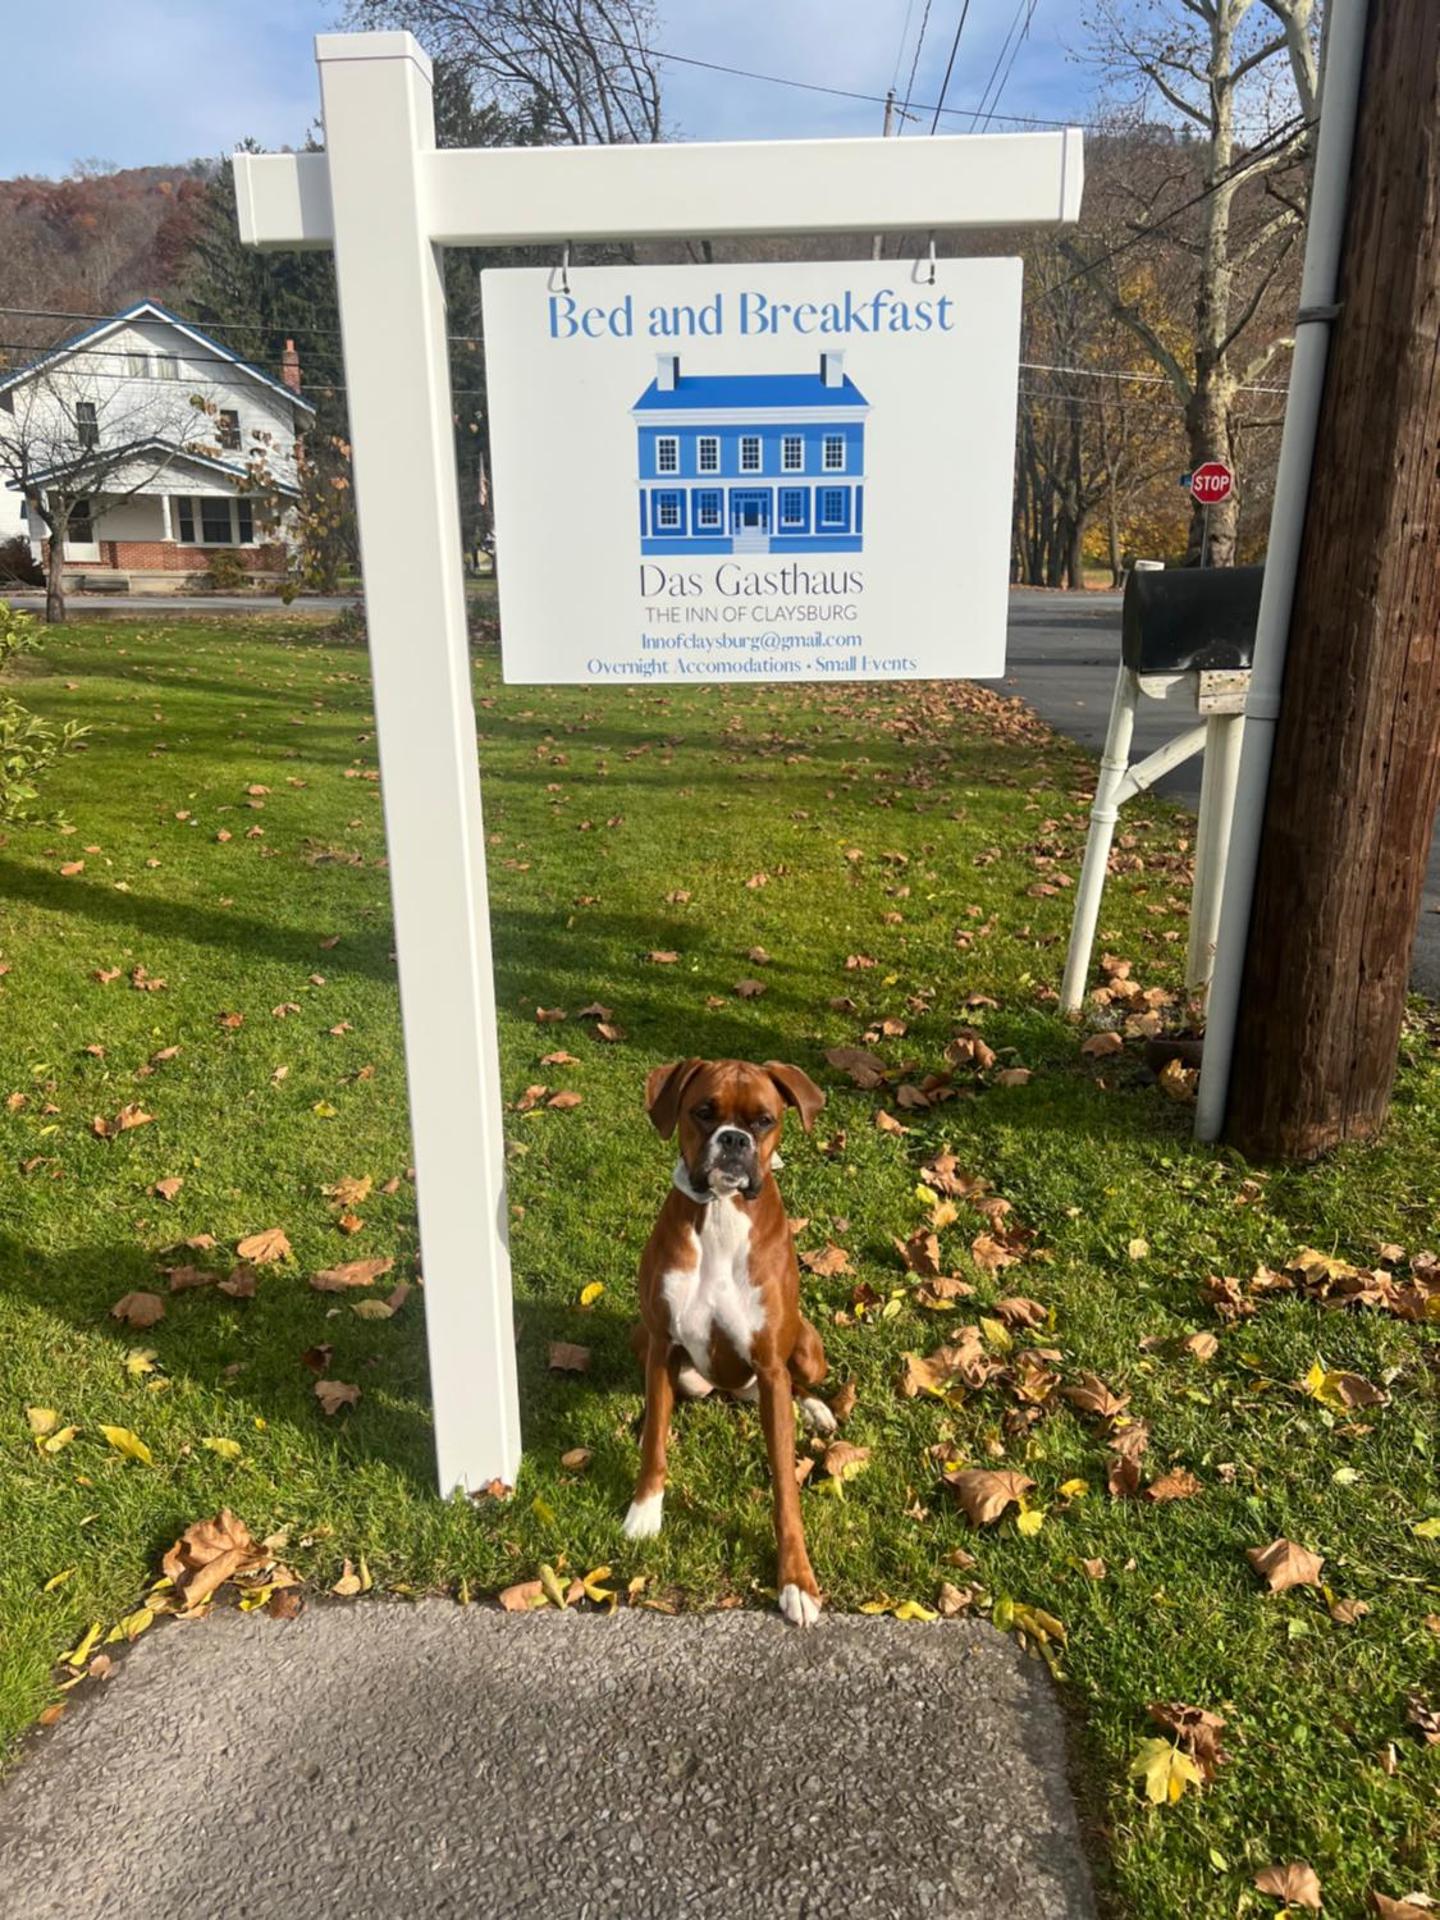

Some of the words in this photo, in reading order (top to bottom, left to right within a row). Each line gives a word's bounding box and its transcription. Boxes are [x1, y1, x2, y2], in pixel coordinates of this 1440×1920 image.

[547, 295, 634, 339] Bed
[648, 293, 723, 337] and
[739, 289, 955, 336] Breakfast
[1194, 475, 1230, 491] STOP
[639, 564, 703, 598] Das
[715, 562, 864, 597] Gasthaus
[645, 606, 681, 624] THE
[685, 606, 719, 623] INN
[722, 605, 748, 623] OF
[751, 604, 858, 623] CLAYSBURG
[641, 631, 863, 653] Innofclaysburg@gmail.com
[586, 658, 669, 677] Overnight
[676, 656, 802, 674] Accomodations
[815, 656, 857, 672] Small
[861, 655, 918, 672] Events
